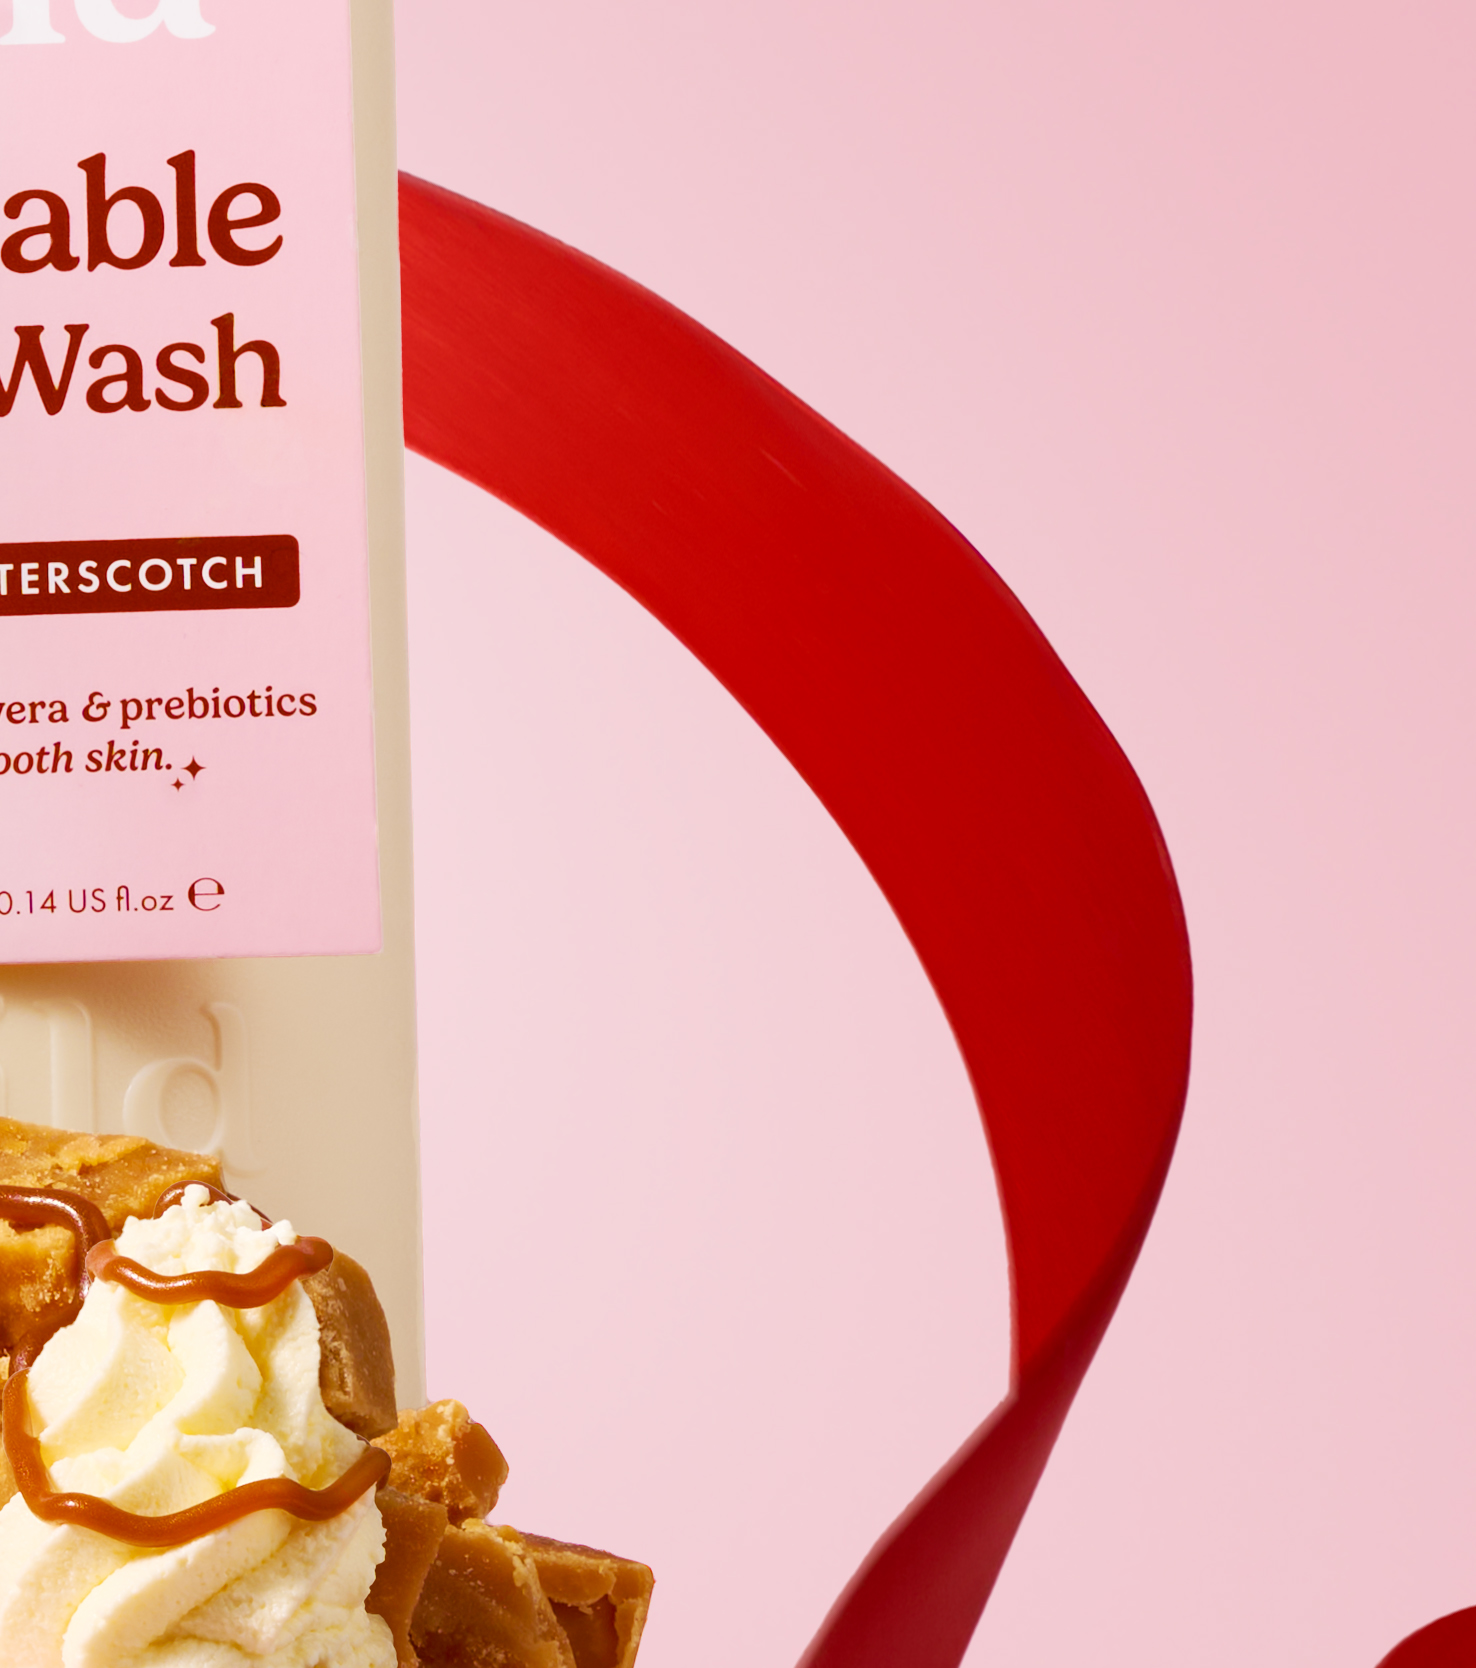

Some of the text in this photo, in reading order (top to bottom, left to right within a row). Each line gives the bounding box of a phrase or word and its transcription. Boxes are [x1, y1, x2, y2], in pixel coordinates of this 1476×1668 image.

[81, 691, 112, 723] &
[119, 685, 318, 729] prebiotics
[85, 739, 174, 774] skin.
[68, 887, 106, 914] US
[116, 885, 174, 912] fl.oz
